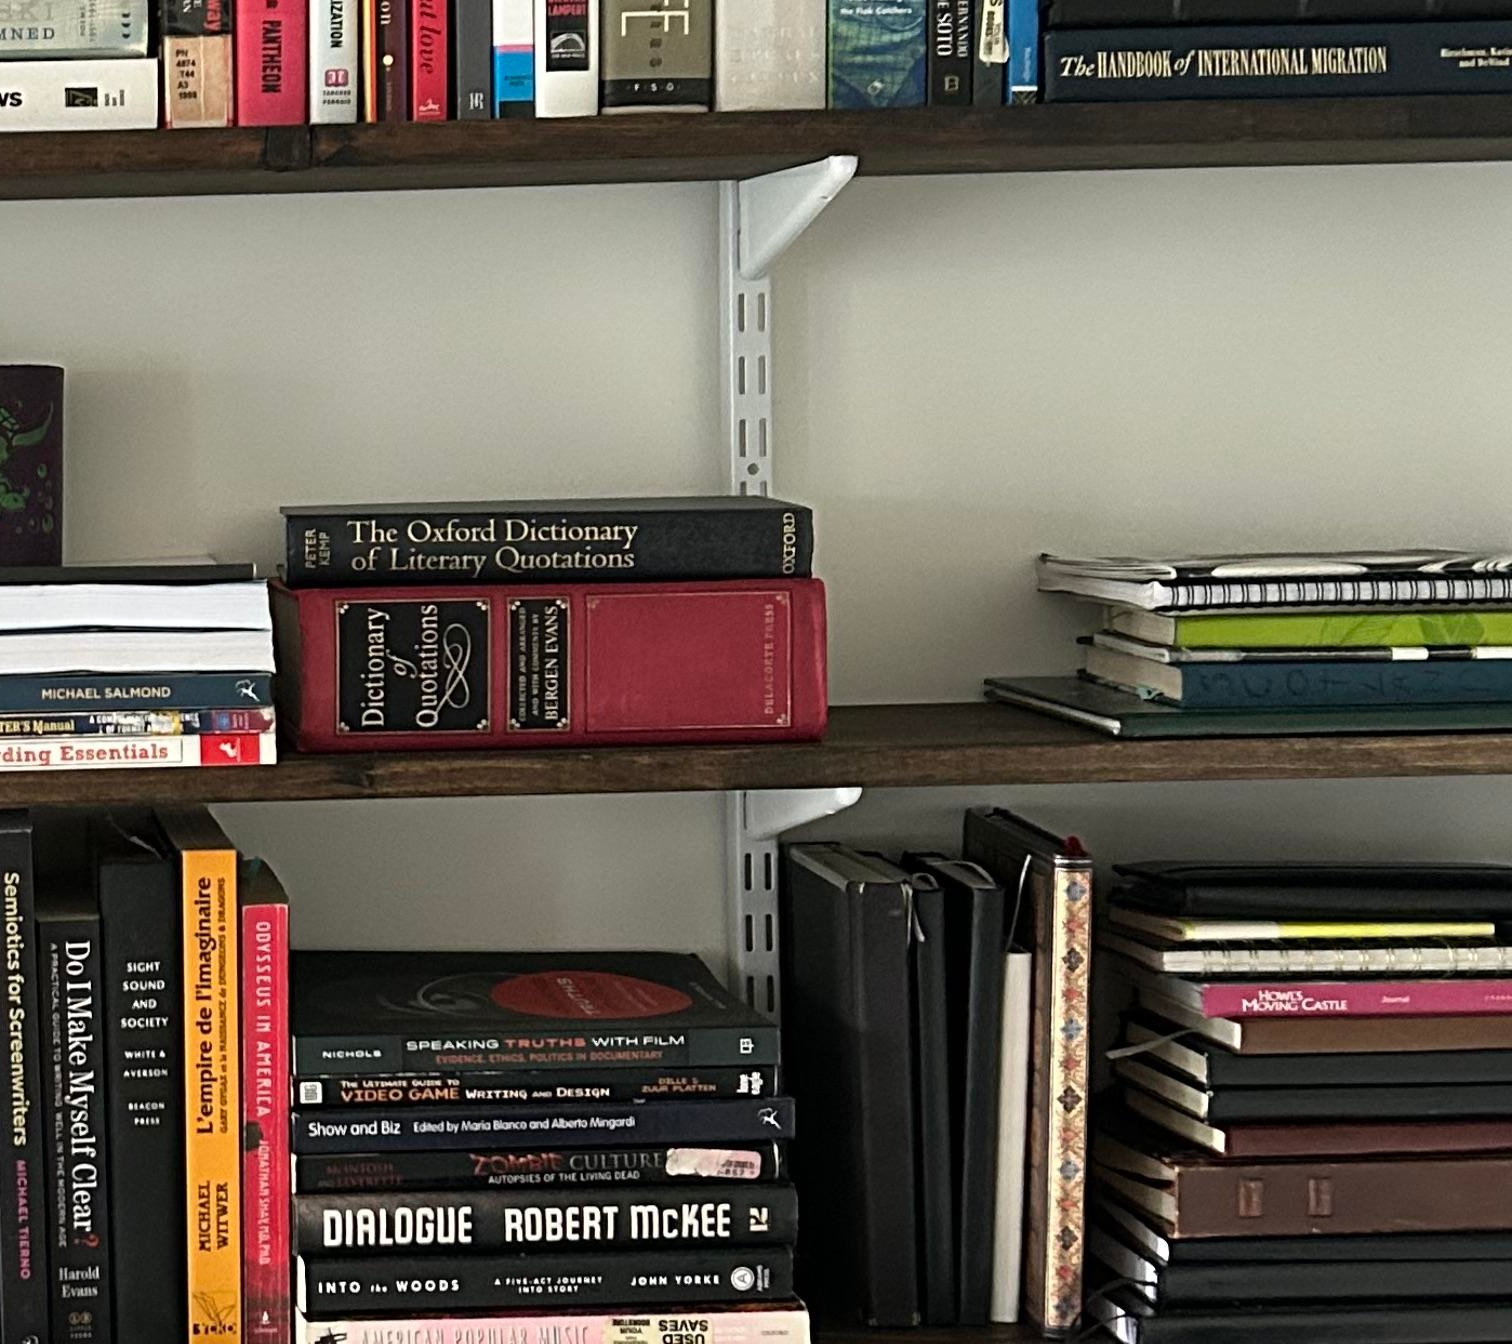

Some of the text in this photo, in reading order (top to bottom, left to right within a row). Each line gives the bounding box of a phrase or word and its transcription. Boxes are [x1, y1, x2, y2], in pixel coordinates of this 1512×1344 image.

[348, 520, 638, 546] The Oxford Dictionary
[783, 512, 796, 574] OXFORD
[352, 547, 635, 578] of Literary Quotations
[362, 608, 388, 726] Dictionary
[392, 654, 418, 678] of
[416, 604, 438, 728] Quotations
[41, 686, 171, 700] MICHAEL SALMOND
[60, 743, 168, 761] Essentials
[127, 961, 160, 973] SIGHT
[122, 980, 165, 991] SOUND
[4, 872, 30, 1147] Semiotics for Screenwriters
[121, 1016, 168, 1028] SOCIETY
[322, 1206, 472, 1247] DIALOGUE
[505, 1205, 619, 1242] ROBERT
[659, 1319, 708, 1332] SAVES
